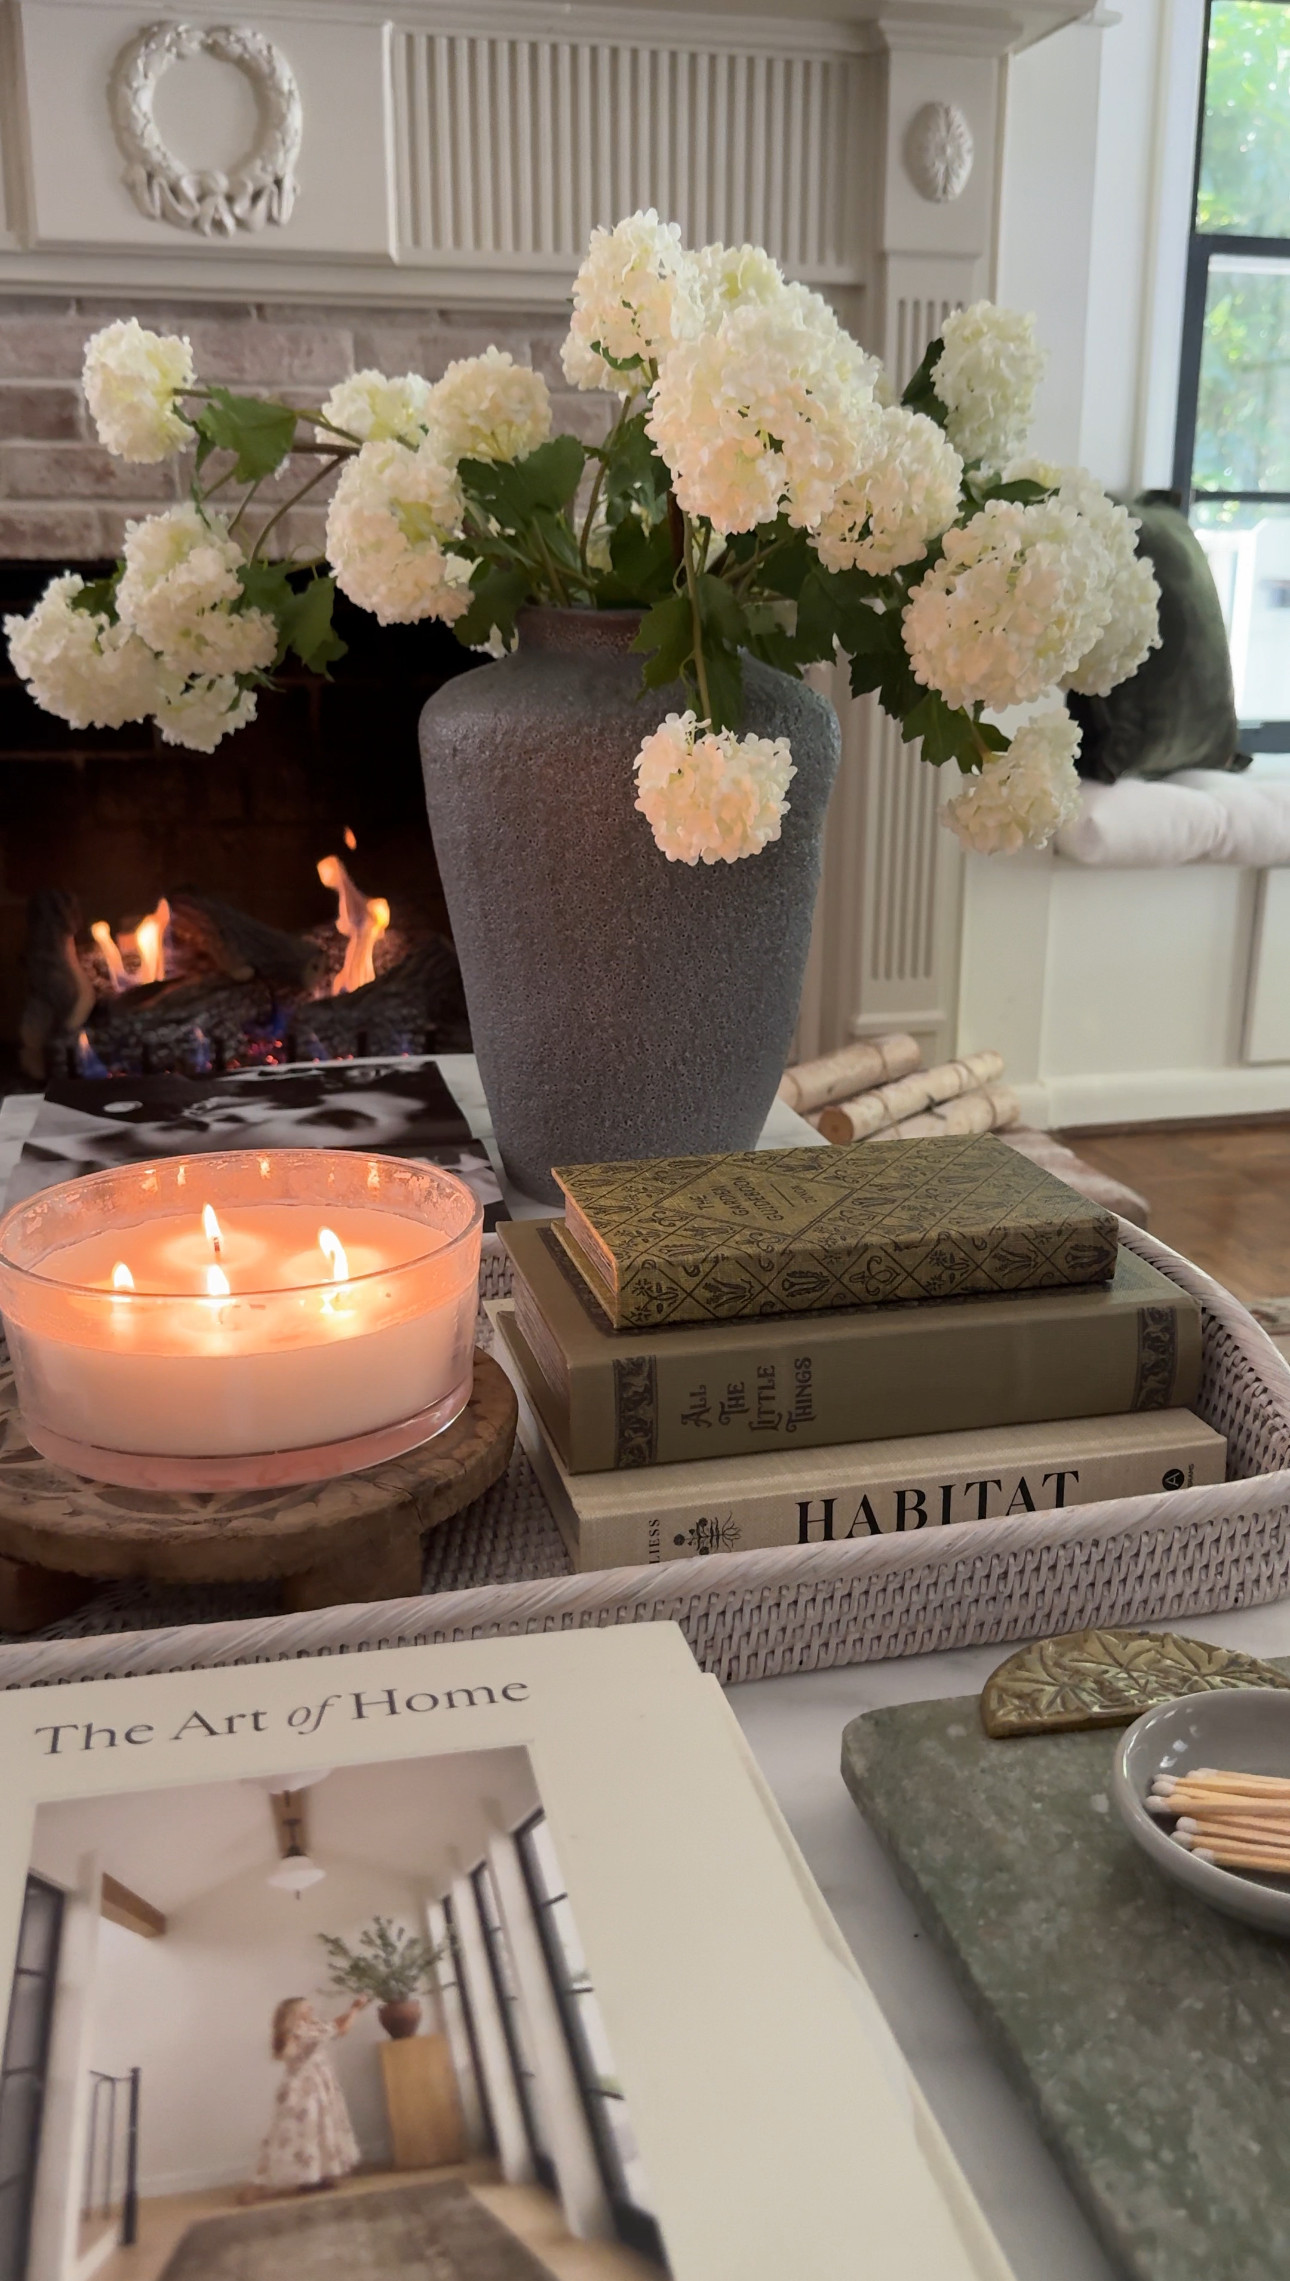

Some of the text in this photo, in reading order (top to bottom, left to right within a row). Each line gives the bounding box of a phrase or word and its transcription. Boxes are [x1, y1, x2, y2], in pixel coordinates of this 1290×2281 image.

[689, 1194, 715, 1211] THE
[709, 1184, 750, 1217] GARDEN
[731, 1175, 785, 1222] GUIDEBOOK
[680, 1384, 713, 1429] ALL
[718, 1381, 750, 1426] THE
[748, 1365, 783, 1432] LITTLE
[785, 1356, 817, 1433] THINGS
[795, 1470, 1080, 1545] HABITAT
[648, 1519, 660, 1565] LIESS
[34, 1681, 531, 1755] The Art of Home
